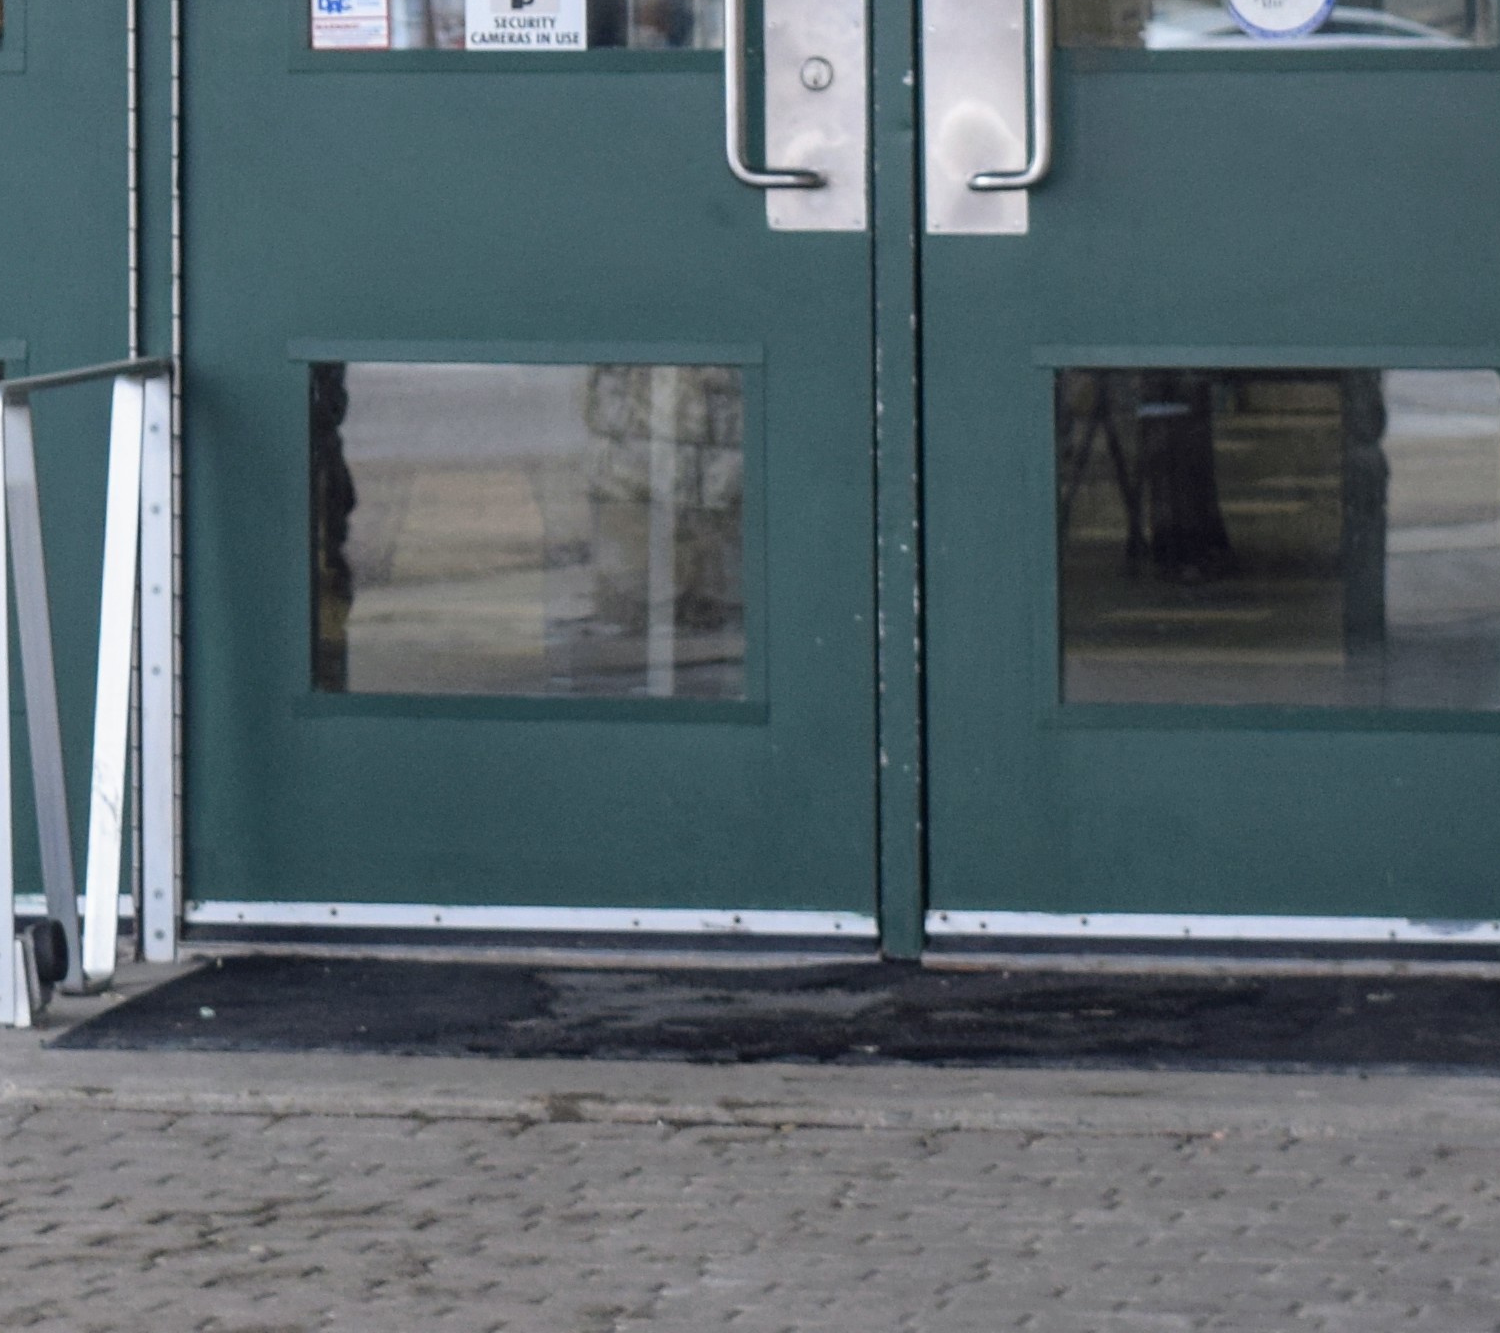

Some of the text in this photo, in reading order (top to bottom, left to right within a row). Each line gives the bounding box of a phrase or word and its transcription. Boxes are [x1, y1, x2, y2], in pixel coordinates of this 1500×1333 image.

[493, 16, 556, 29] SECURITY
[470, 31, 580, 45] CAMERAS IN USE
